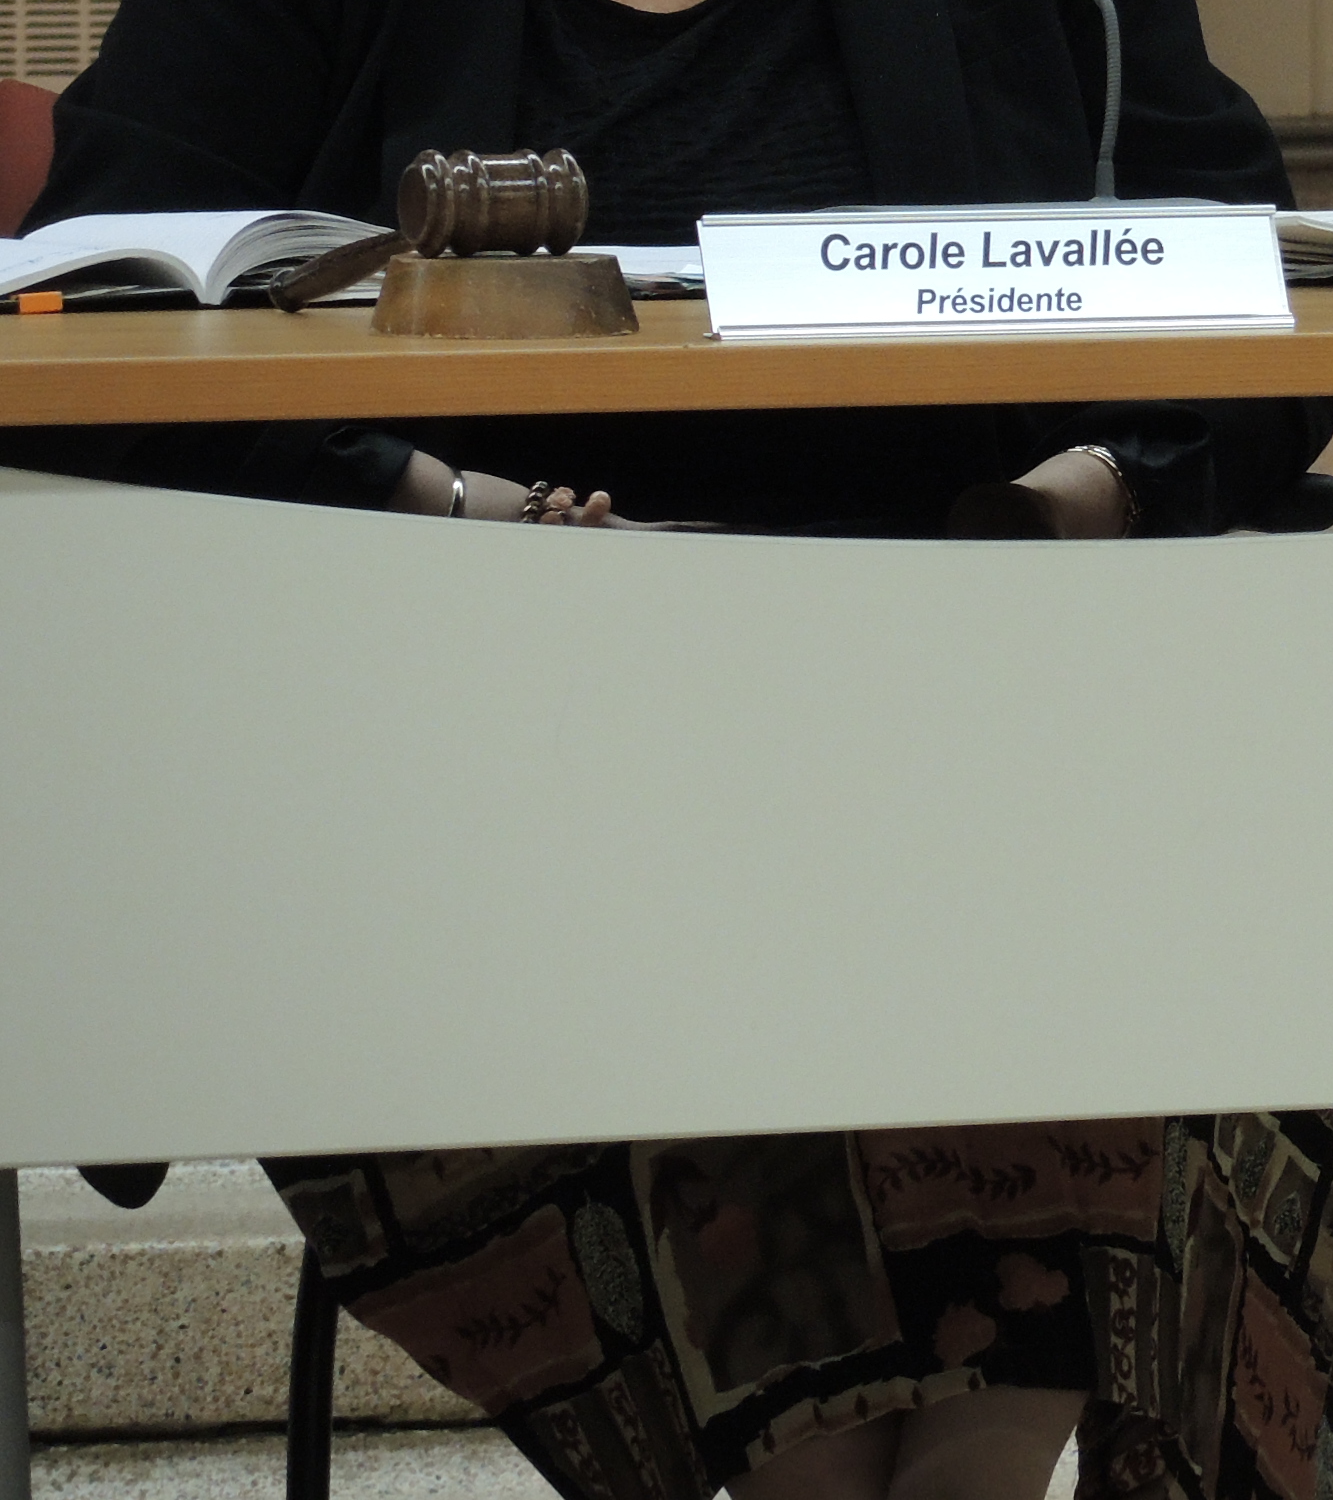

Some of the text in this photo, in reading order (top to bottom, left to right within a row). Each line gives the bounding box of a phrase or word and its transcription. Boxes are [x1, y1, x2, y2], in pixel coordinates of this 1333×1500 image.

[820, 228, 1165, 271] Carole Lavallée
[916, 286, 1083, 315] Présidente
